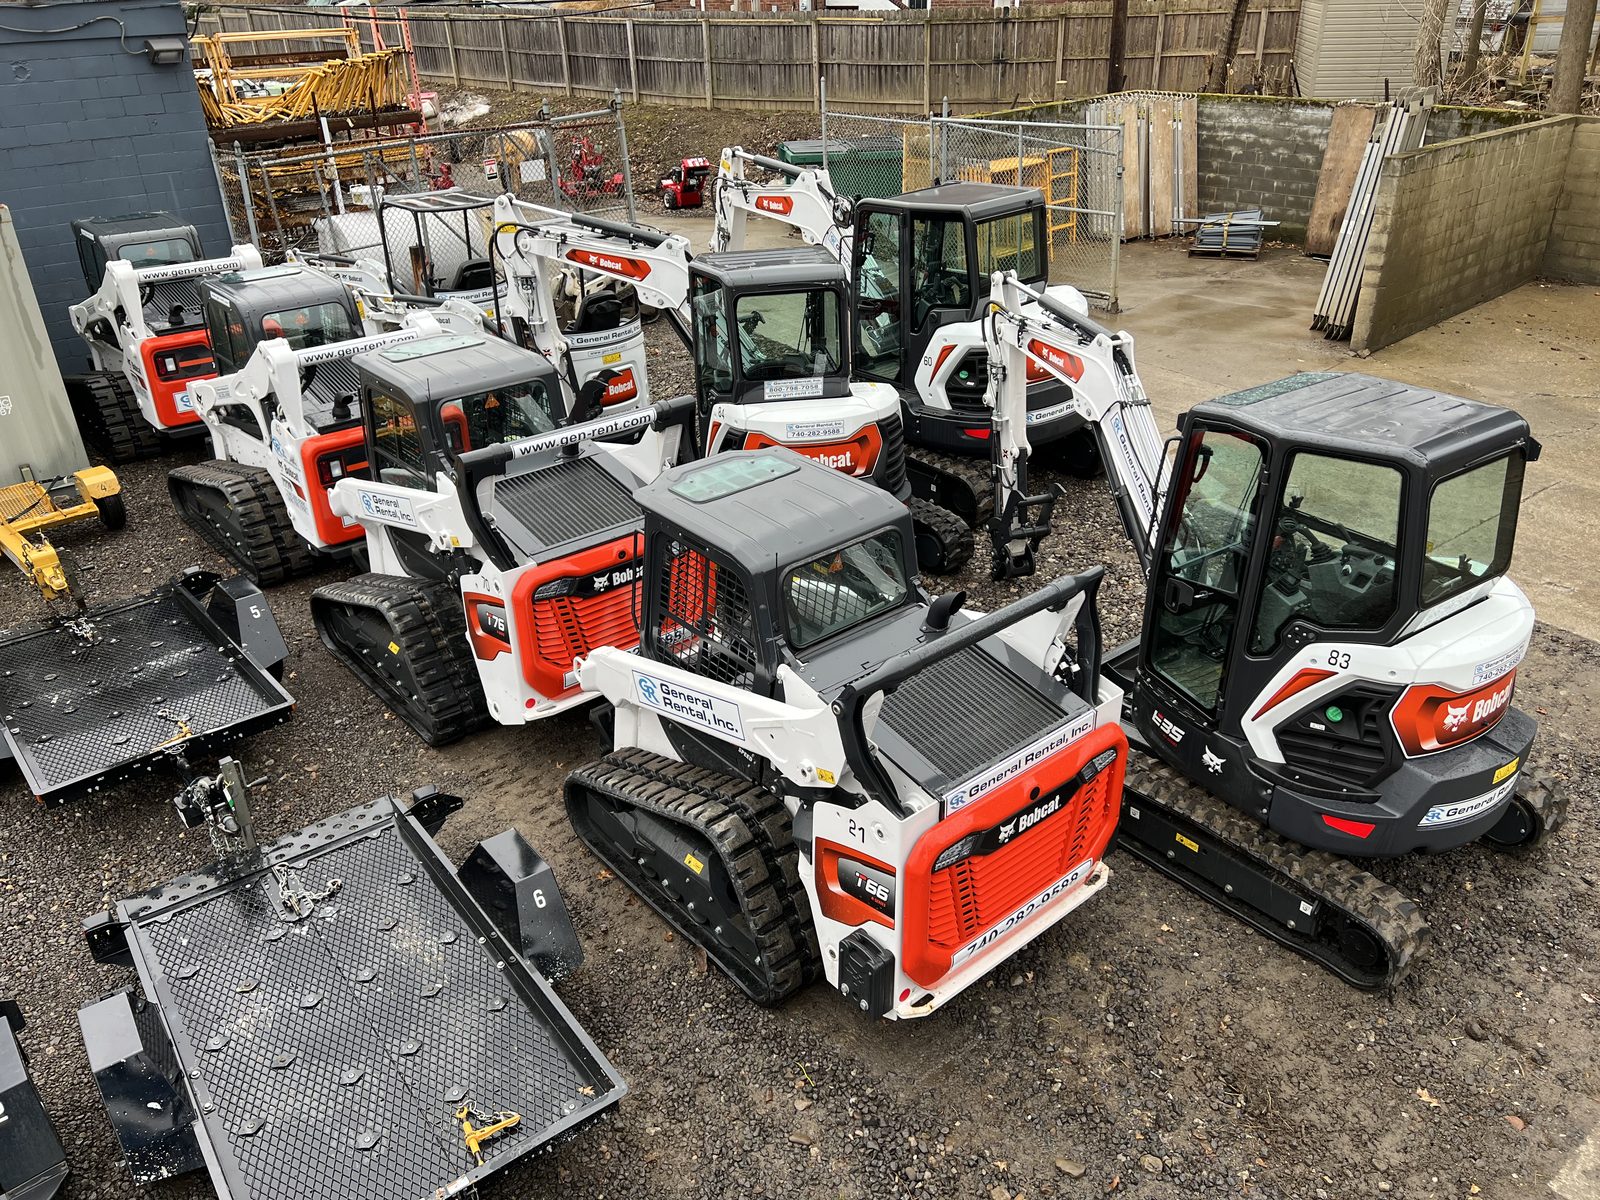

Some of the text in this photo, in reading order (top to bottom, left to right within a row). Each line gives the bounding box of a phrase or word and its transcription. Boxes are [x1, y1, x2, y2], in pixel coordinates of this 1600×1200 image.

[142, 261, 239, 280] www.gen-rent.com
[599, 257, 622, 271] Bobcat
[576, 333, 611, 344] General
[612, 327, 634, 339] Rental,
[923, 355, 933, 367] 60
[608, 380, 634, 396] Bobcat
[1035, 407, 1066, 420] General
[519, 413, 651, 456] www.gen-rent.com
[791, 428, 841, 437] 740-282-9588
[1119, 434, 1141, 481] General
[100, 484, 107, 492] 4
[372, 495, 400, 508] General
[375, 505, 414, 521] Rental, Inc.
[249, 604, 261, 619] 5
[486, 611, 505, 632] T76
[1327, 649, 1352, 670] 83
[660, 683, 714, 711] General
[662, 696, 739, 733] Rental, Inc.
[1151, 709, 1186, 743] E35
[969, 723, 1092, 797] General Rental, Inc.
[1018, 794, 1061, 832] Bobcat
[1446, 790, 1496, 818] General
[848, 818, 866, 844] 21
[855, 871, 890, 902] T66
[532, 888, 547, 909] 6
